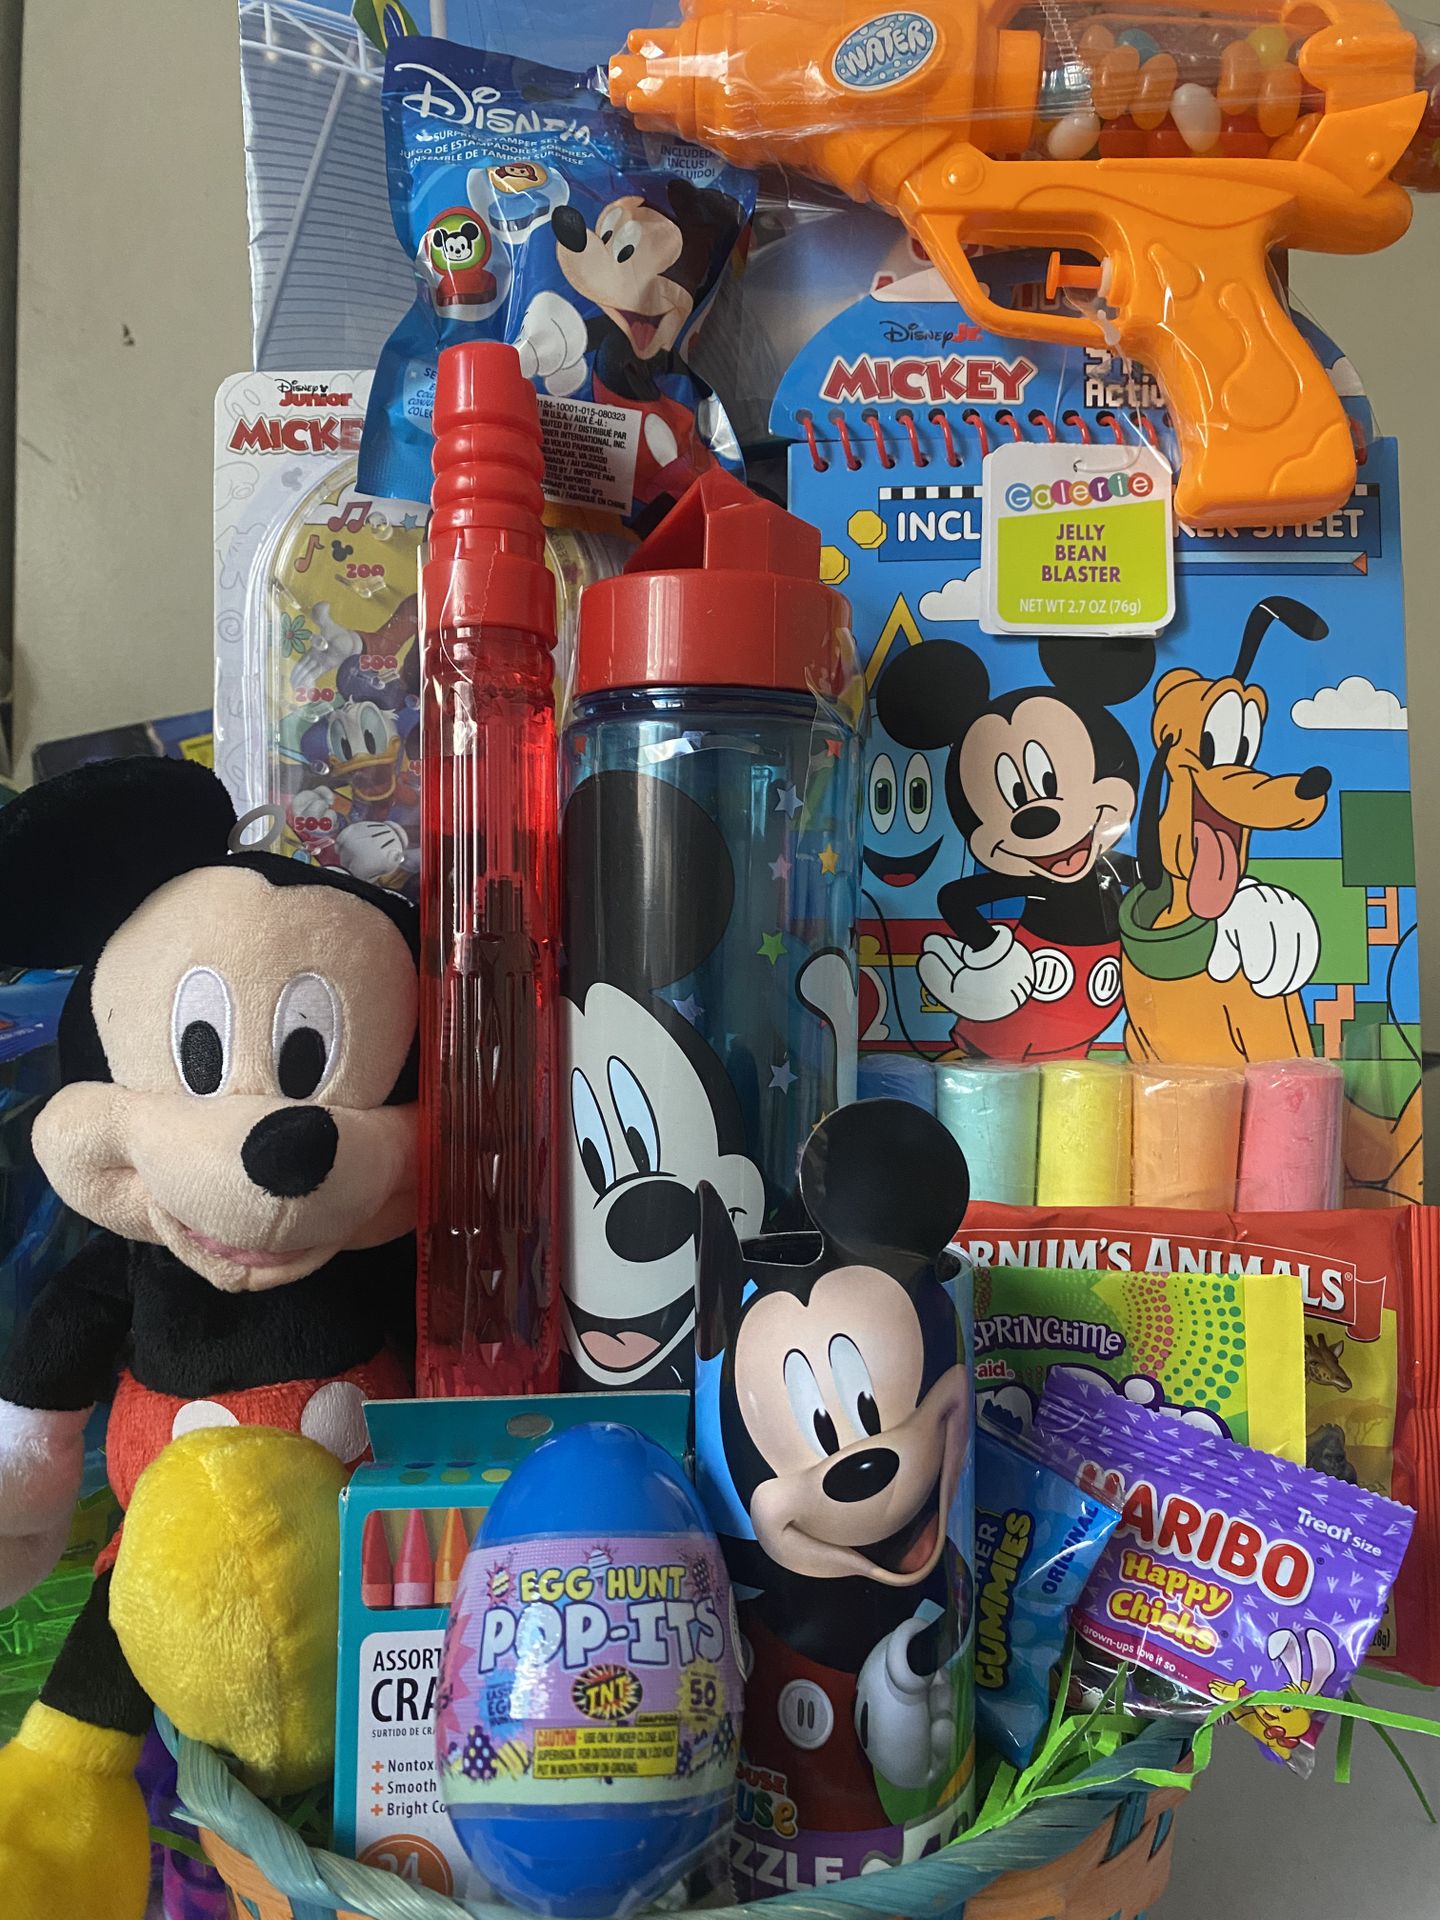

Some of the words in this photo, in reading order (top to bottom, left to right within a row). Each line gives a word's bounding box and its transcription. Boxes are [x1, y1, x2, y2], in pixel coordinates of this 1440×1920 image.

[842, 20, 927, 76] WATER
[435, 145, 448, 154] DE
[540, 143, 596, 158] SORPRESA
[465, 150, 479, 159] DE
[483, 149, 530, 160] TAMPON
[880, 320, 954, 349] Disney
[823, 356, 1033, 401] MICKEY
[274, 379, 319, 397] Disney
[279, 391, 353, 407] Junior
[1006, 473, 1152, 511] Galerie
[1056, 524, 1106, 541] JELLY
[1055, 544, 1106, 562] BEAN
[346, 563, 385, 579] 200
[1041, 565, 1121, 583] BLASTER
[1019, 598, 1042, 613] NET
[1045, 599, 1065, 613] WT
[1067, 600, 1085, 613] 2.7
[1088, 600, 1106, 614] OZ
[1109, 598, 1142, 616] (76g)
[358, 654, 398, 671] 500
[296, 687, 335, 703] 200
[293, 816, 333, 832] 500
[1297, 1506, 1352, 1543] Treat
[1351, 1536, 1382, 1557] size
[520, 1567, 593, 1602] EGG
[606, 1566, 686, 1600] HUNT
[1123, 1550, 1231, 1612] Happy
[975, 1511, 1032, 1689] GUMMIES
[1110, 1590, 1215, 1650] Chicks
[479, 1598, 725, 1674] POP-ITS
[1083, 1624, 1134, 1655] grown-ups
[1164, 1660, 1176, 1672] so
[586, 1674, 628, 1717] TNT
[690, 1678, 717, 1708] 50
[372, 1728, 407, 1738] SURTIDO
[409, 1727, 419, 1736] DE
[387, 1778, 437, 1795] Smooth
[387, 1800, 428, 1819] Bright
